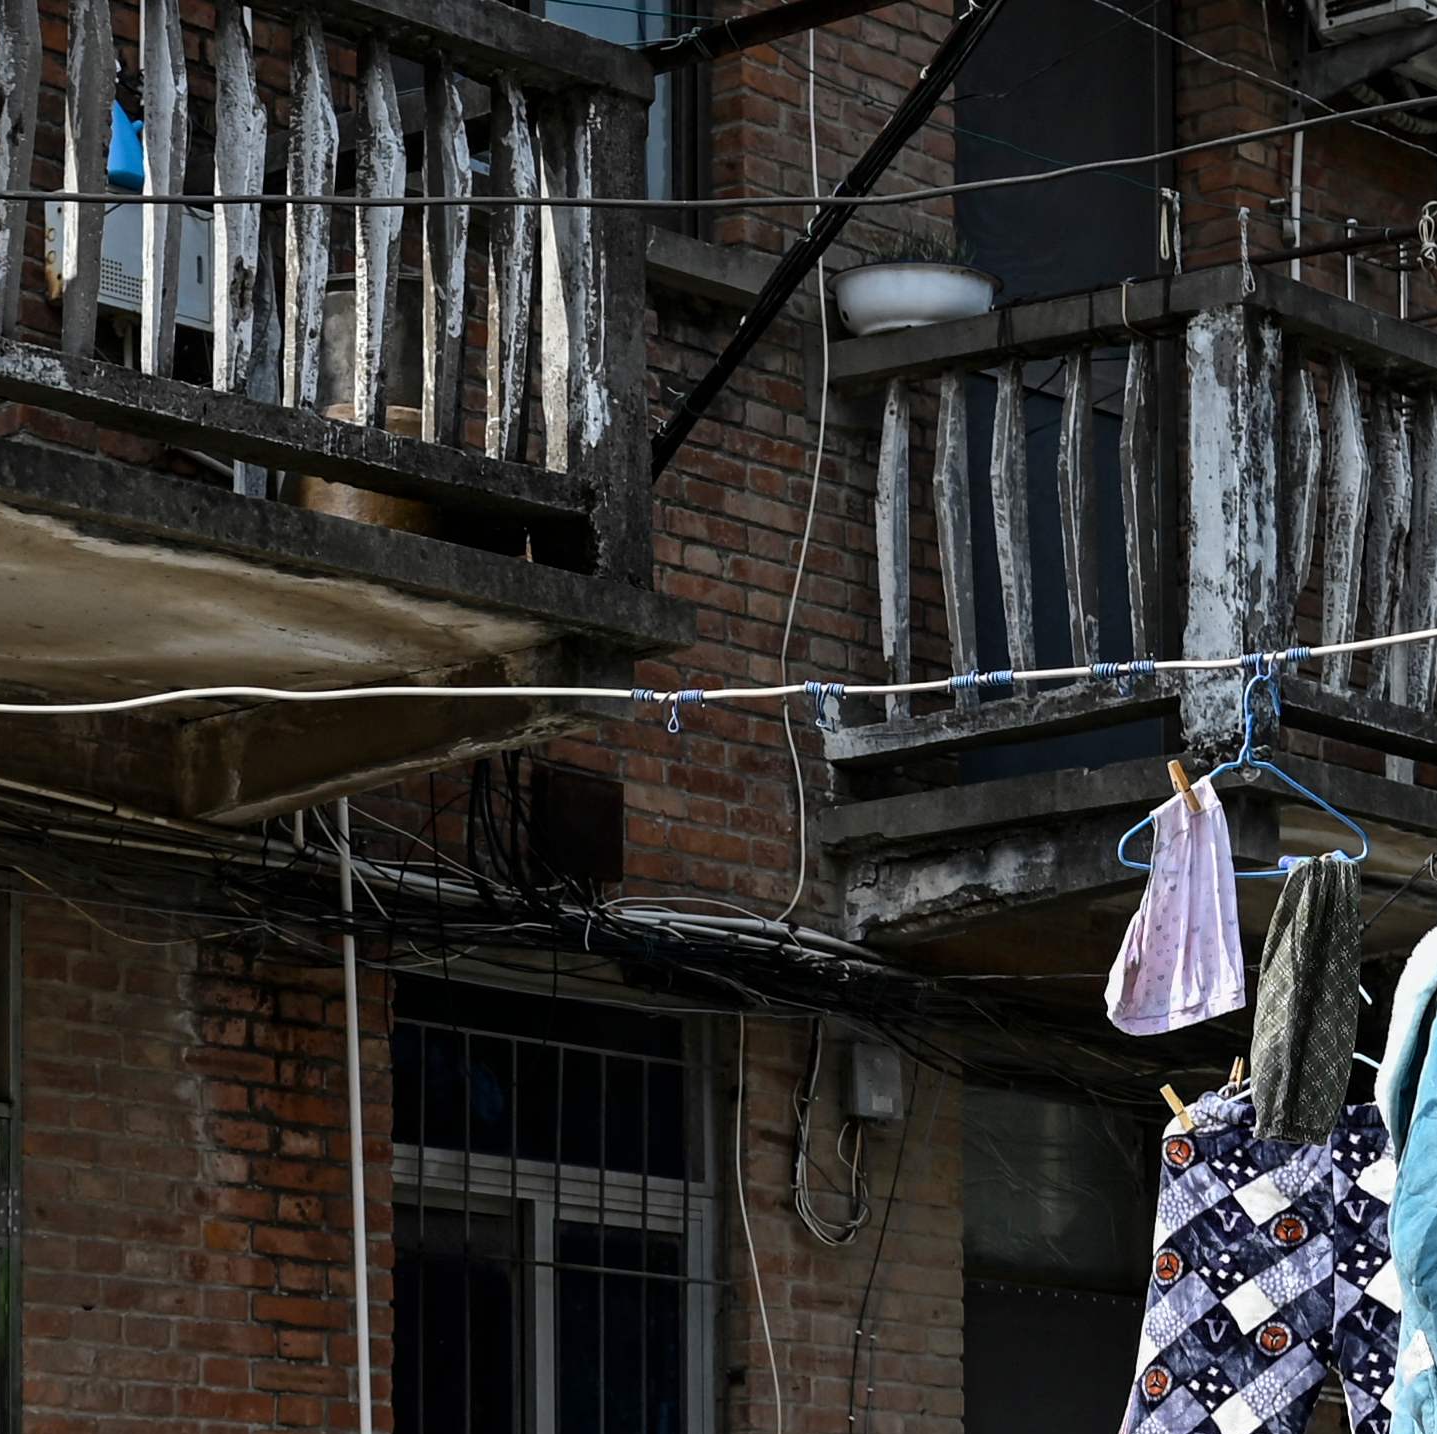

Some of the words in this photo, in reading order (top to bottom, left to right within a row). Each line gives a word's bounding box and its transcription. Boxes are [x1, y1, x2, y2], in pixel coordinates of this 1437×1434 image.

[1214, 1208, 1242, 1232] V
[1344, 1199, 1369, 1223] V
[1204, 1318, 1230, 1343] V
[1354, 1307, 1379, 1331] V
